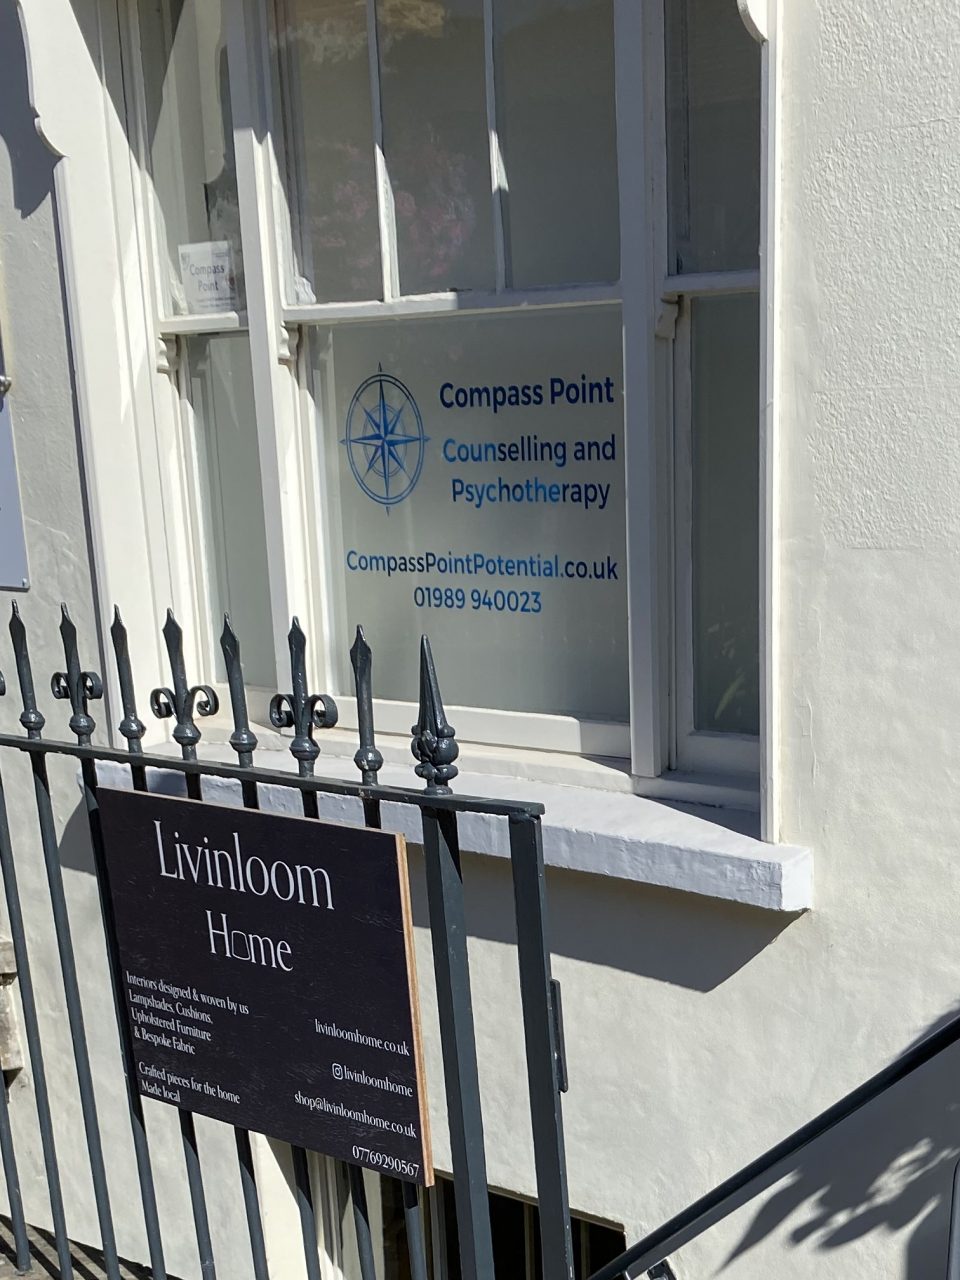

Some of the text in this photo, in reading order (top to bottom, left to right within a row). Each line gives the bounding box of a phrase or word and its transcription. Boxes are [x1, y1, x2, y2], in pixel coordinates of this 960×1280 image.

[190, 264, 225, 277] Compass
[198, 279, 219, 291] Point
[439, 374, 614, 413] Compass Point
[442, 434, 616, 467] Counselling and
[451, 477, 611, 509] Psychotherapy
[346, 550, 619, 580] CompassPointPotential.co.uk
[413, 587, 542, 612] 01989 940023
[153, 820, 335, 910] Livinloom
[126, 970, 249, 1015] Interiors designed & woven by us
[131, 1007, 211, 1041] Upholstered Furniture
[134, 1026, 196, 1055] & Bespoke Fabric
[315, 1018, 410, 1056] livinloomhome.co.uk
[139, 1061, 240, 1104] Crafted pieces for the home
[141, 1079, 180, 1102] Made local
[344, 1065, 413, 1097] livinloomhome
[294, 1091, 417, 1138] shop@livinloomhome.co.uk
[352, 1145, 420, 1178] 07769290567
